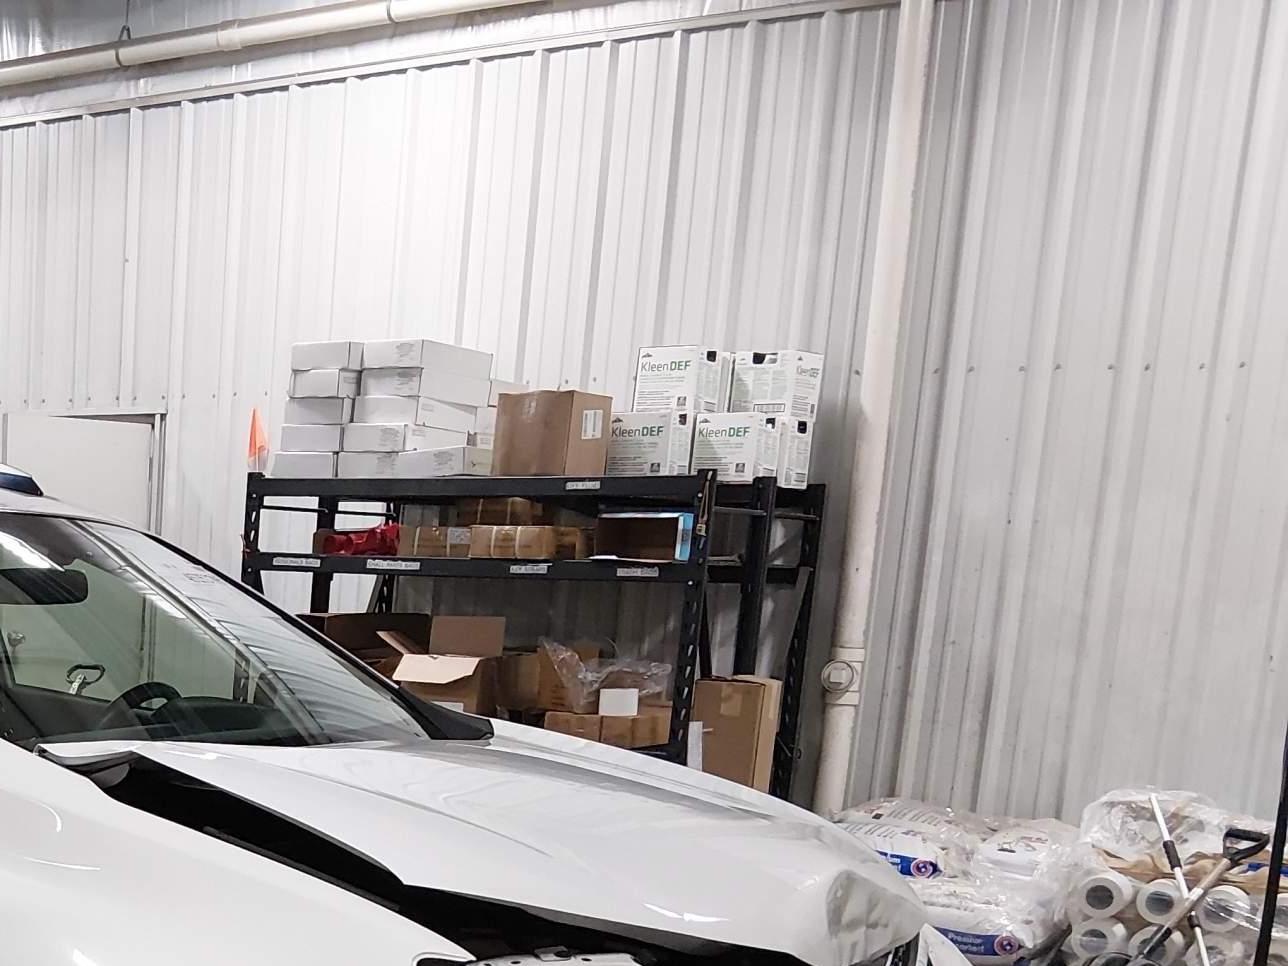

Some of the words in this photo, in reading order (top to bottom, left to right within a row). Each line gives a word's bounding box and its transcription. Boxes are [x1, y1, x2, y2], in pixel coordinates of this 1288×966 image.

[640, 360, 692, 372] KleenDEF
[611, 426, 665, 438] KleenDEF
[698, 426, 751, 438] KleenDEF
